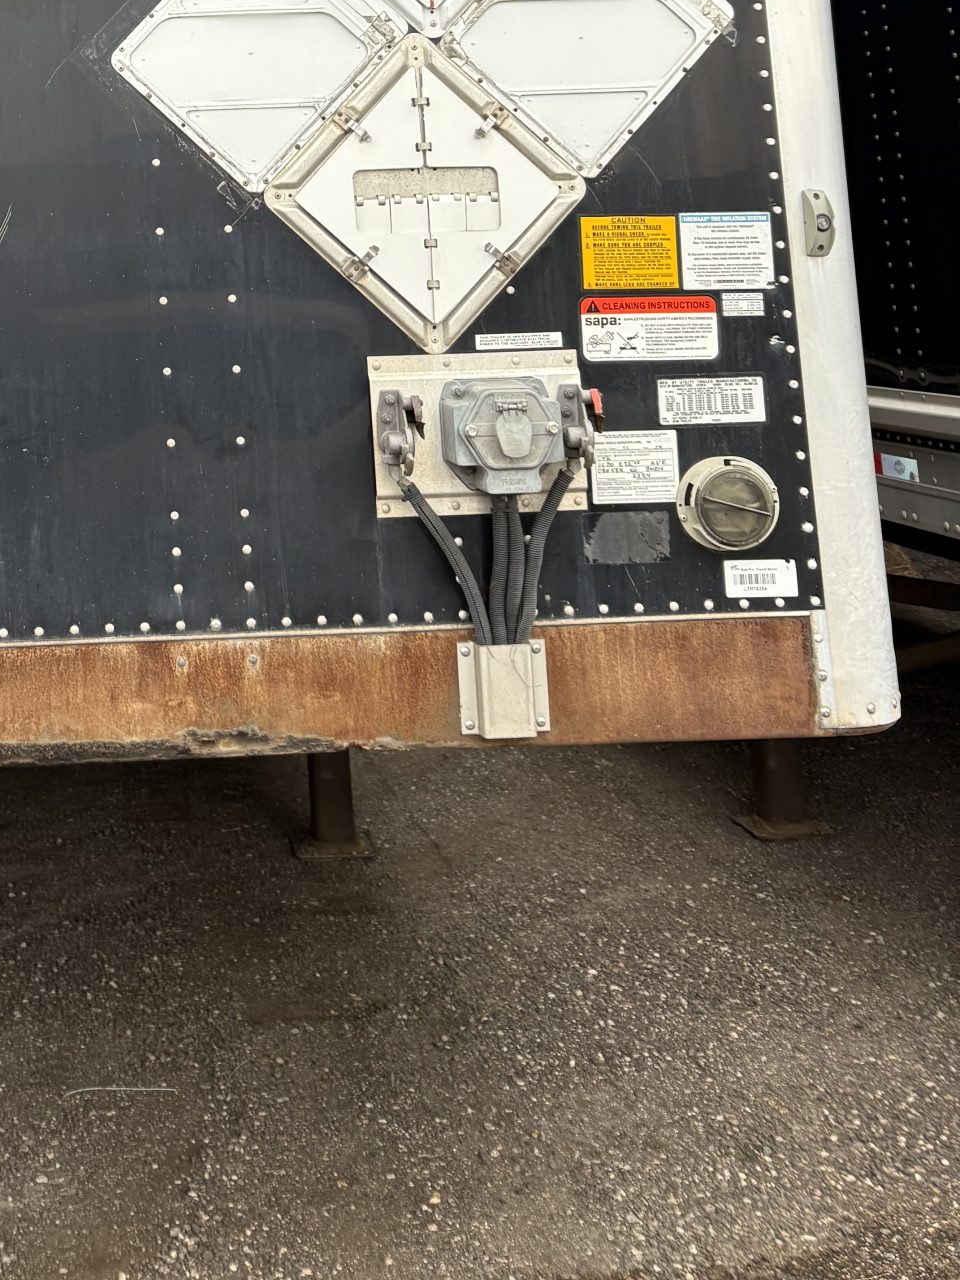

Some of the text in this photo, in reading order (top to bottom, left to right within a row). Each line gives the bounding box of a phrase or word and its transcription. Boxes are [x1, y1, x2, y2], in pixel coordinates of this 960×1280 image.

[602, 300, 710, 310] CLEANING INSTRUCTIONS
[585, 316, 621, 328] sapa:
